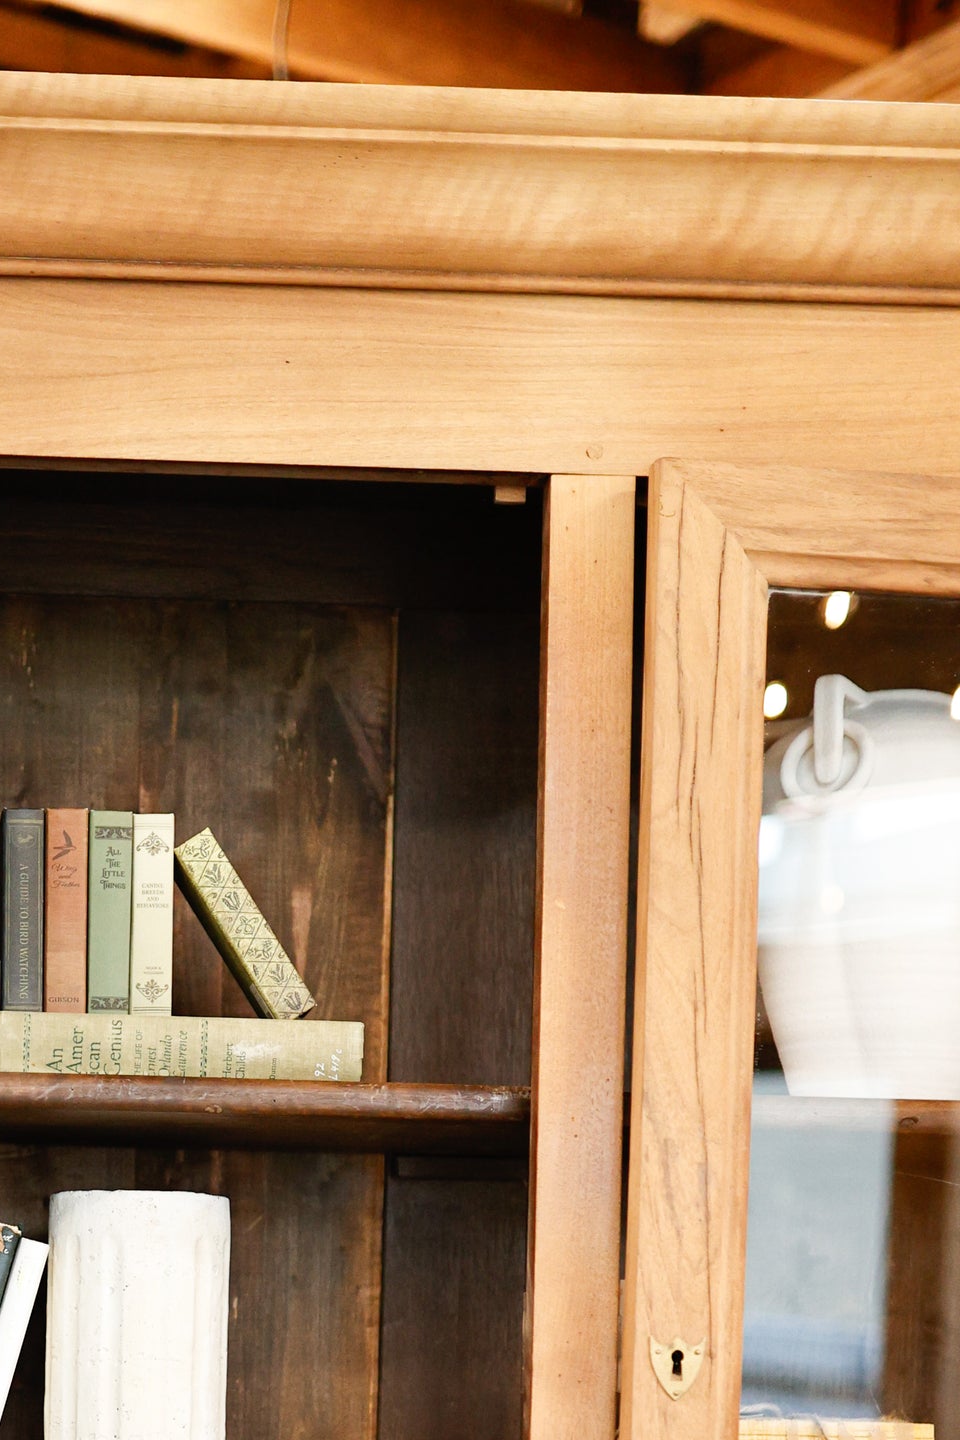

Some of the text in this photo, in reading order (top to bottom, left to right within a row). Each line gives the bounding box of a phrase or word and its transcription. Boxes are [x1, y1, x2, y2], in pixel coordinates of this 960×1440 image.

[19, 872, 29, 903] GUIDE
[100, 880, 126, 890] THINGS
[19, 906, 29, 919] TO
[19, 921, 29, 945] BIRD
[19, 949, 29, 1000] WATCHING
[46, 1047, 64, 1072] An
[104, 1019, 123, 1076] Genius
[314, 1062, 326, 1077] 92
